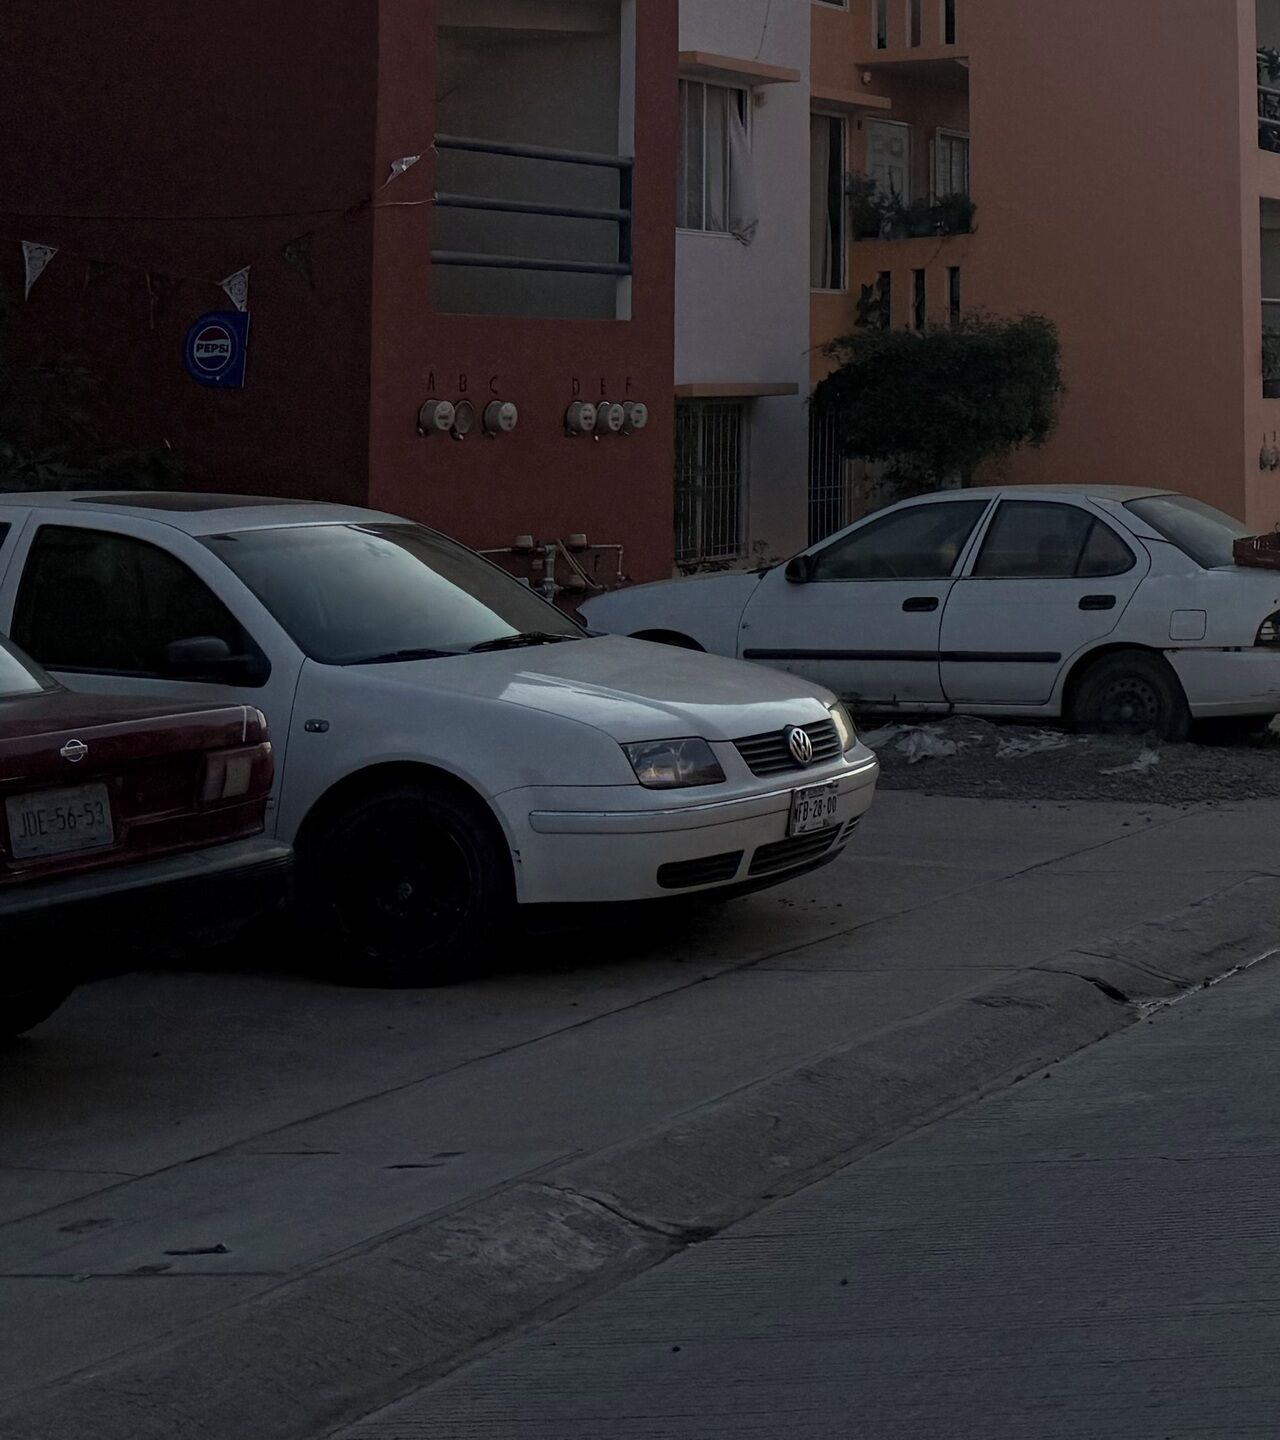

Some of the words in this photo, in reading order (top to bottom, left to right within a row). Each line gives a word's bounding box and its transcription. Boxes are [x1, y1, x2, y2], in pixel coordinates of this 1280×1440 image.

[196, 343, 230, 353] PEPSI
[427, 371, 436, 392] A
[459, 373, 467, 392] B
[489, 375, 498, 394] C
[572, 378, 580, 395] D
[18, 801, 105, 838] JDE-56-53
